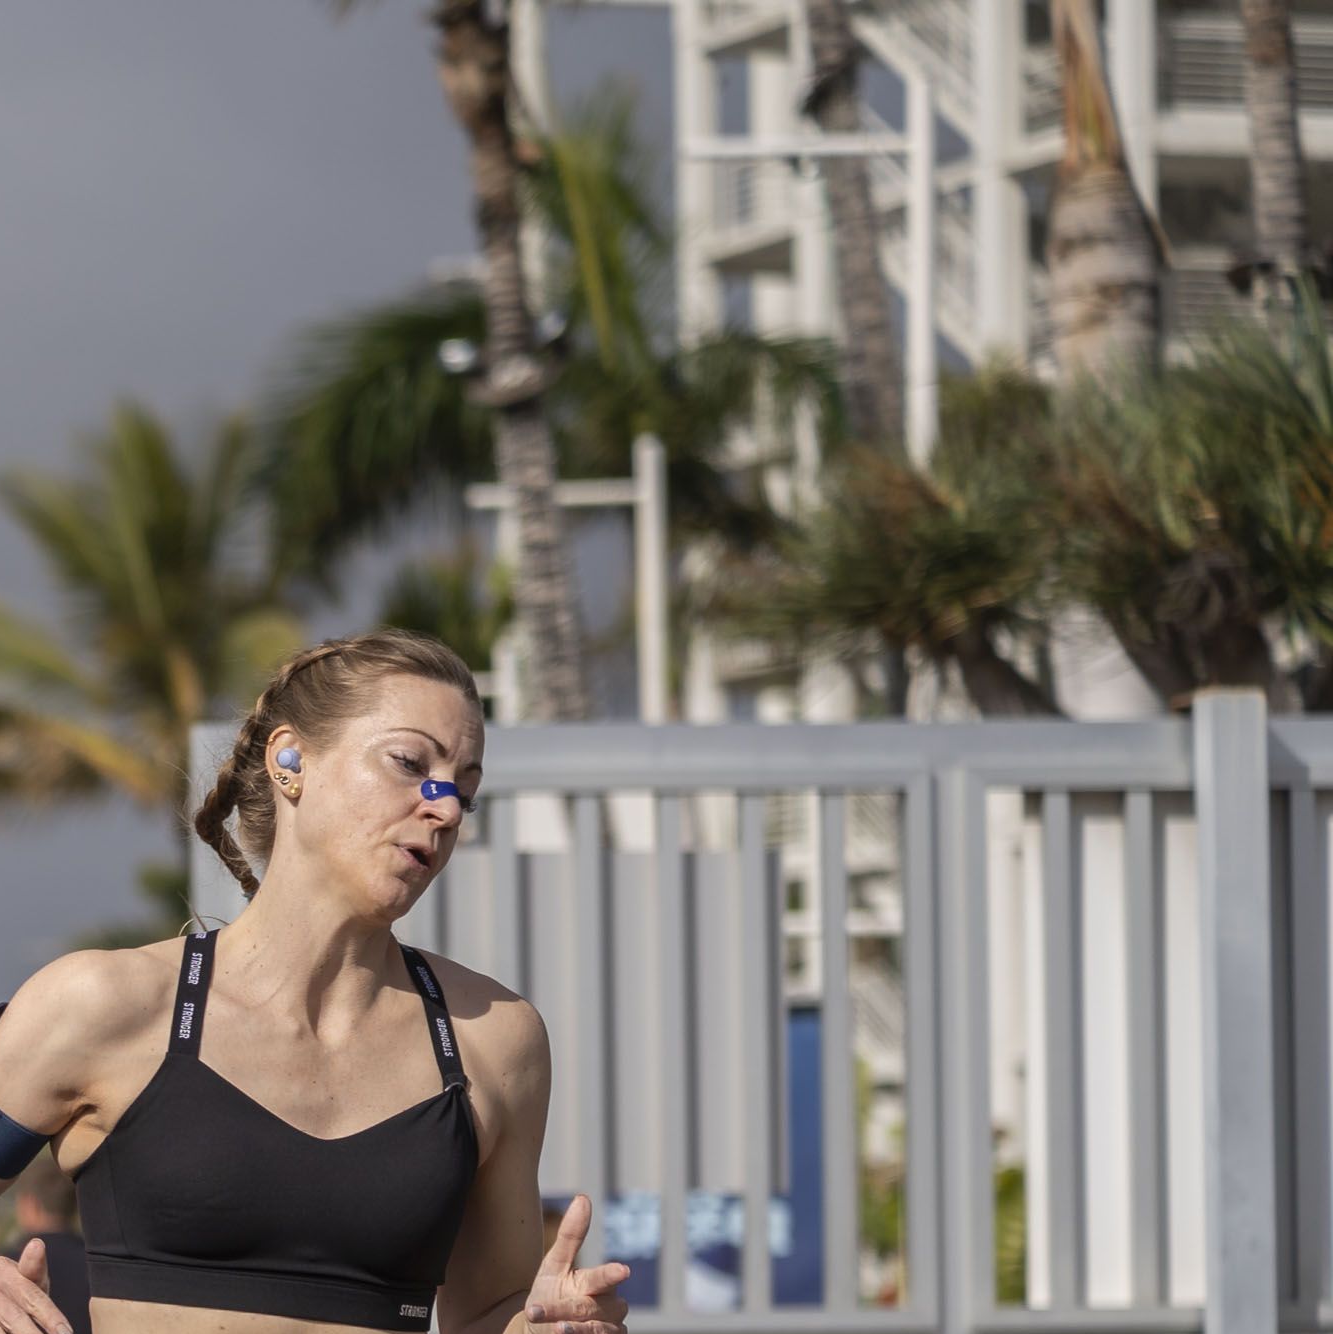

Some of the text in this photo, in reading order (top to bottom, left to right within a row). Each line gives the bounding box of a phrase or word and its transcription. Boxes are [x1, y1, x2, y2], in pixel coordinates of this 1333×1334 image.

[179, 1002, 195, 1039] STRONGER
[435, 1017, 454, 1057] STRONGER
[399, 1304, 428, 1318] STRONGER
